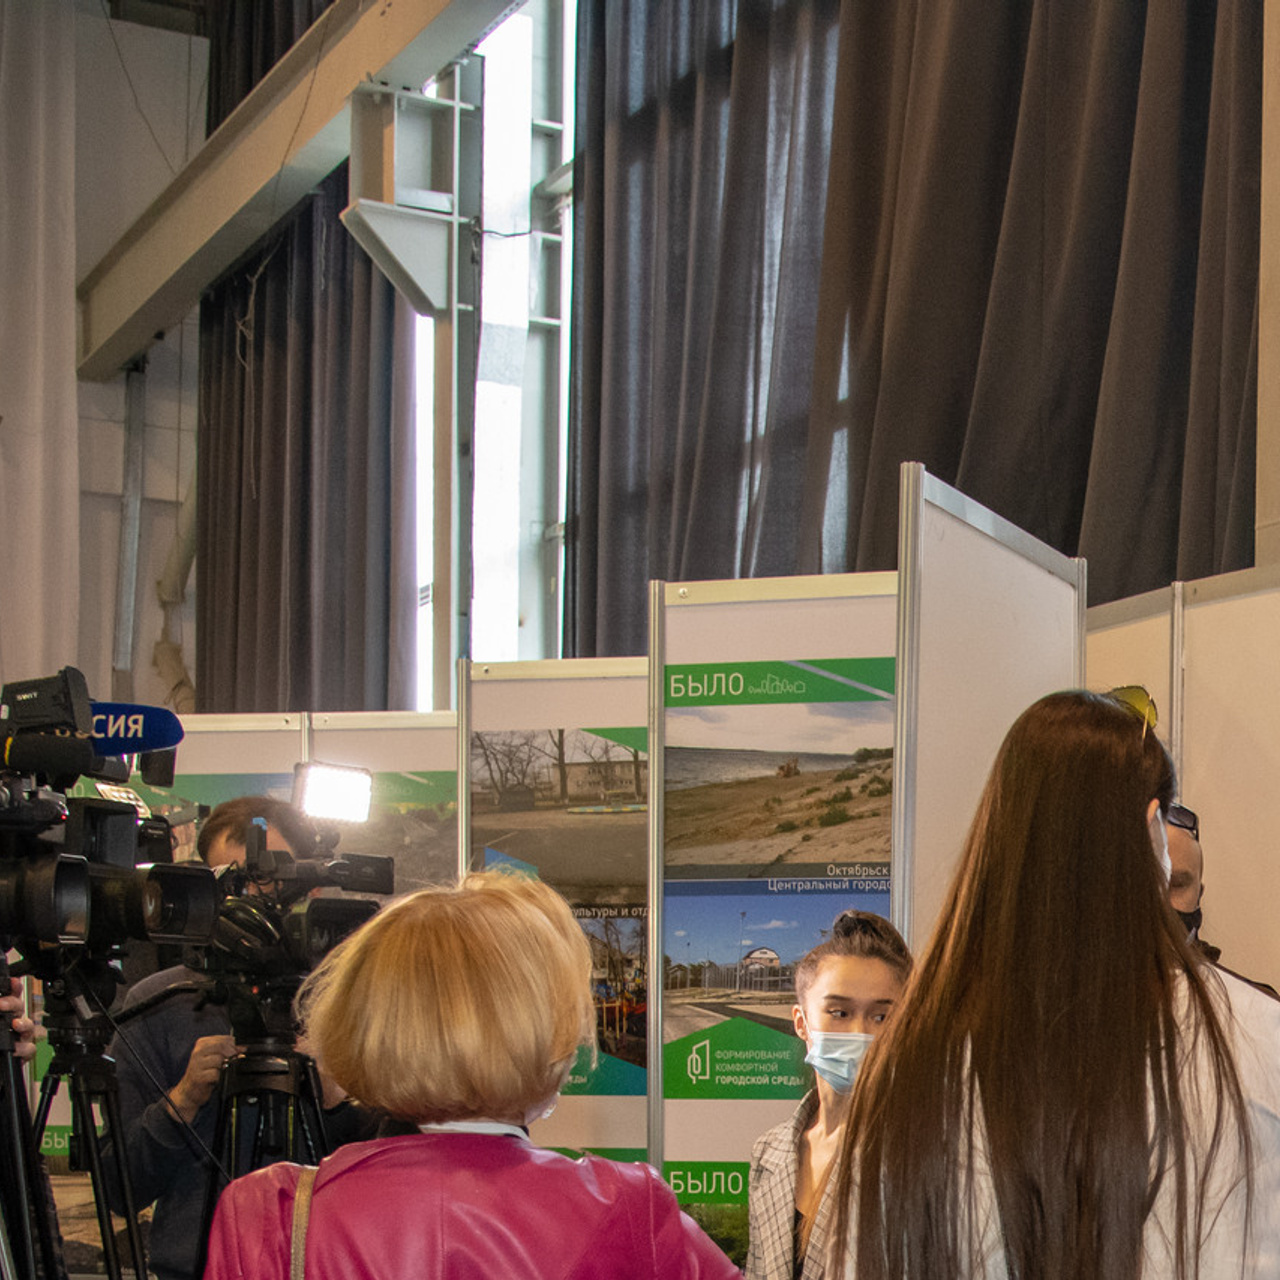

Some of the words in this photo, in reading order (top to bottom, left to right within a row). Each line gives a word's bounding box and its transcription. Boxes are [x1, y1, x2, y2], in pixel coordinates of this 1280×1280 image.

[670, 672, 744, 697] БЫЛО
[827, 864, 889, 877] Октябрьск
[768, 878, 849, 893] Центральный
[571, 907, 618, 918] ультуры
[621, 908, 629, 917] и
[715, 1050, 791, 1060] ФОРМИРОВАНИЕ
[715, 1061, 778, 1072] КОМФОРТНОЙ
[715, 1074, 769, 1087] ГОРОДСКОЙ
[771, 1075, 805, 1087] СРЕДЫ
[41, 1131, 69, 1149] БЫ
[670, 1171, 743, 1195] БЫЛО
